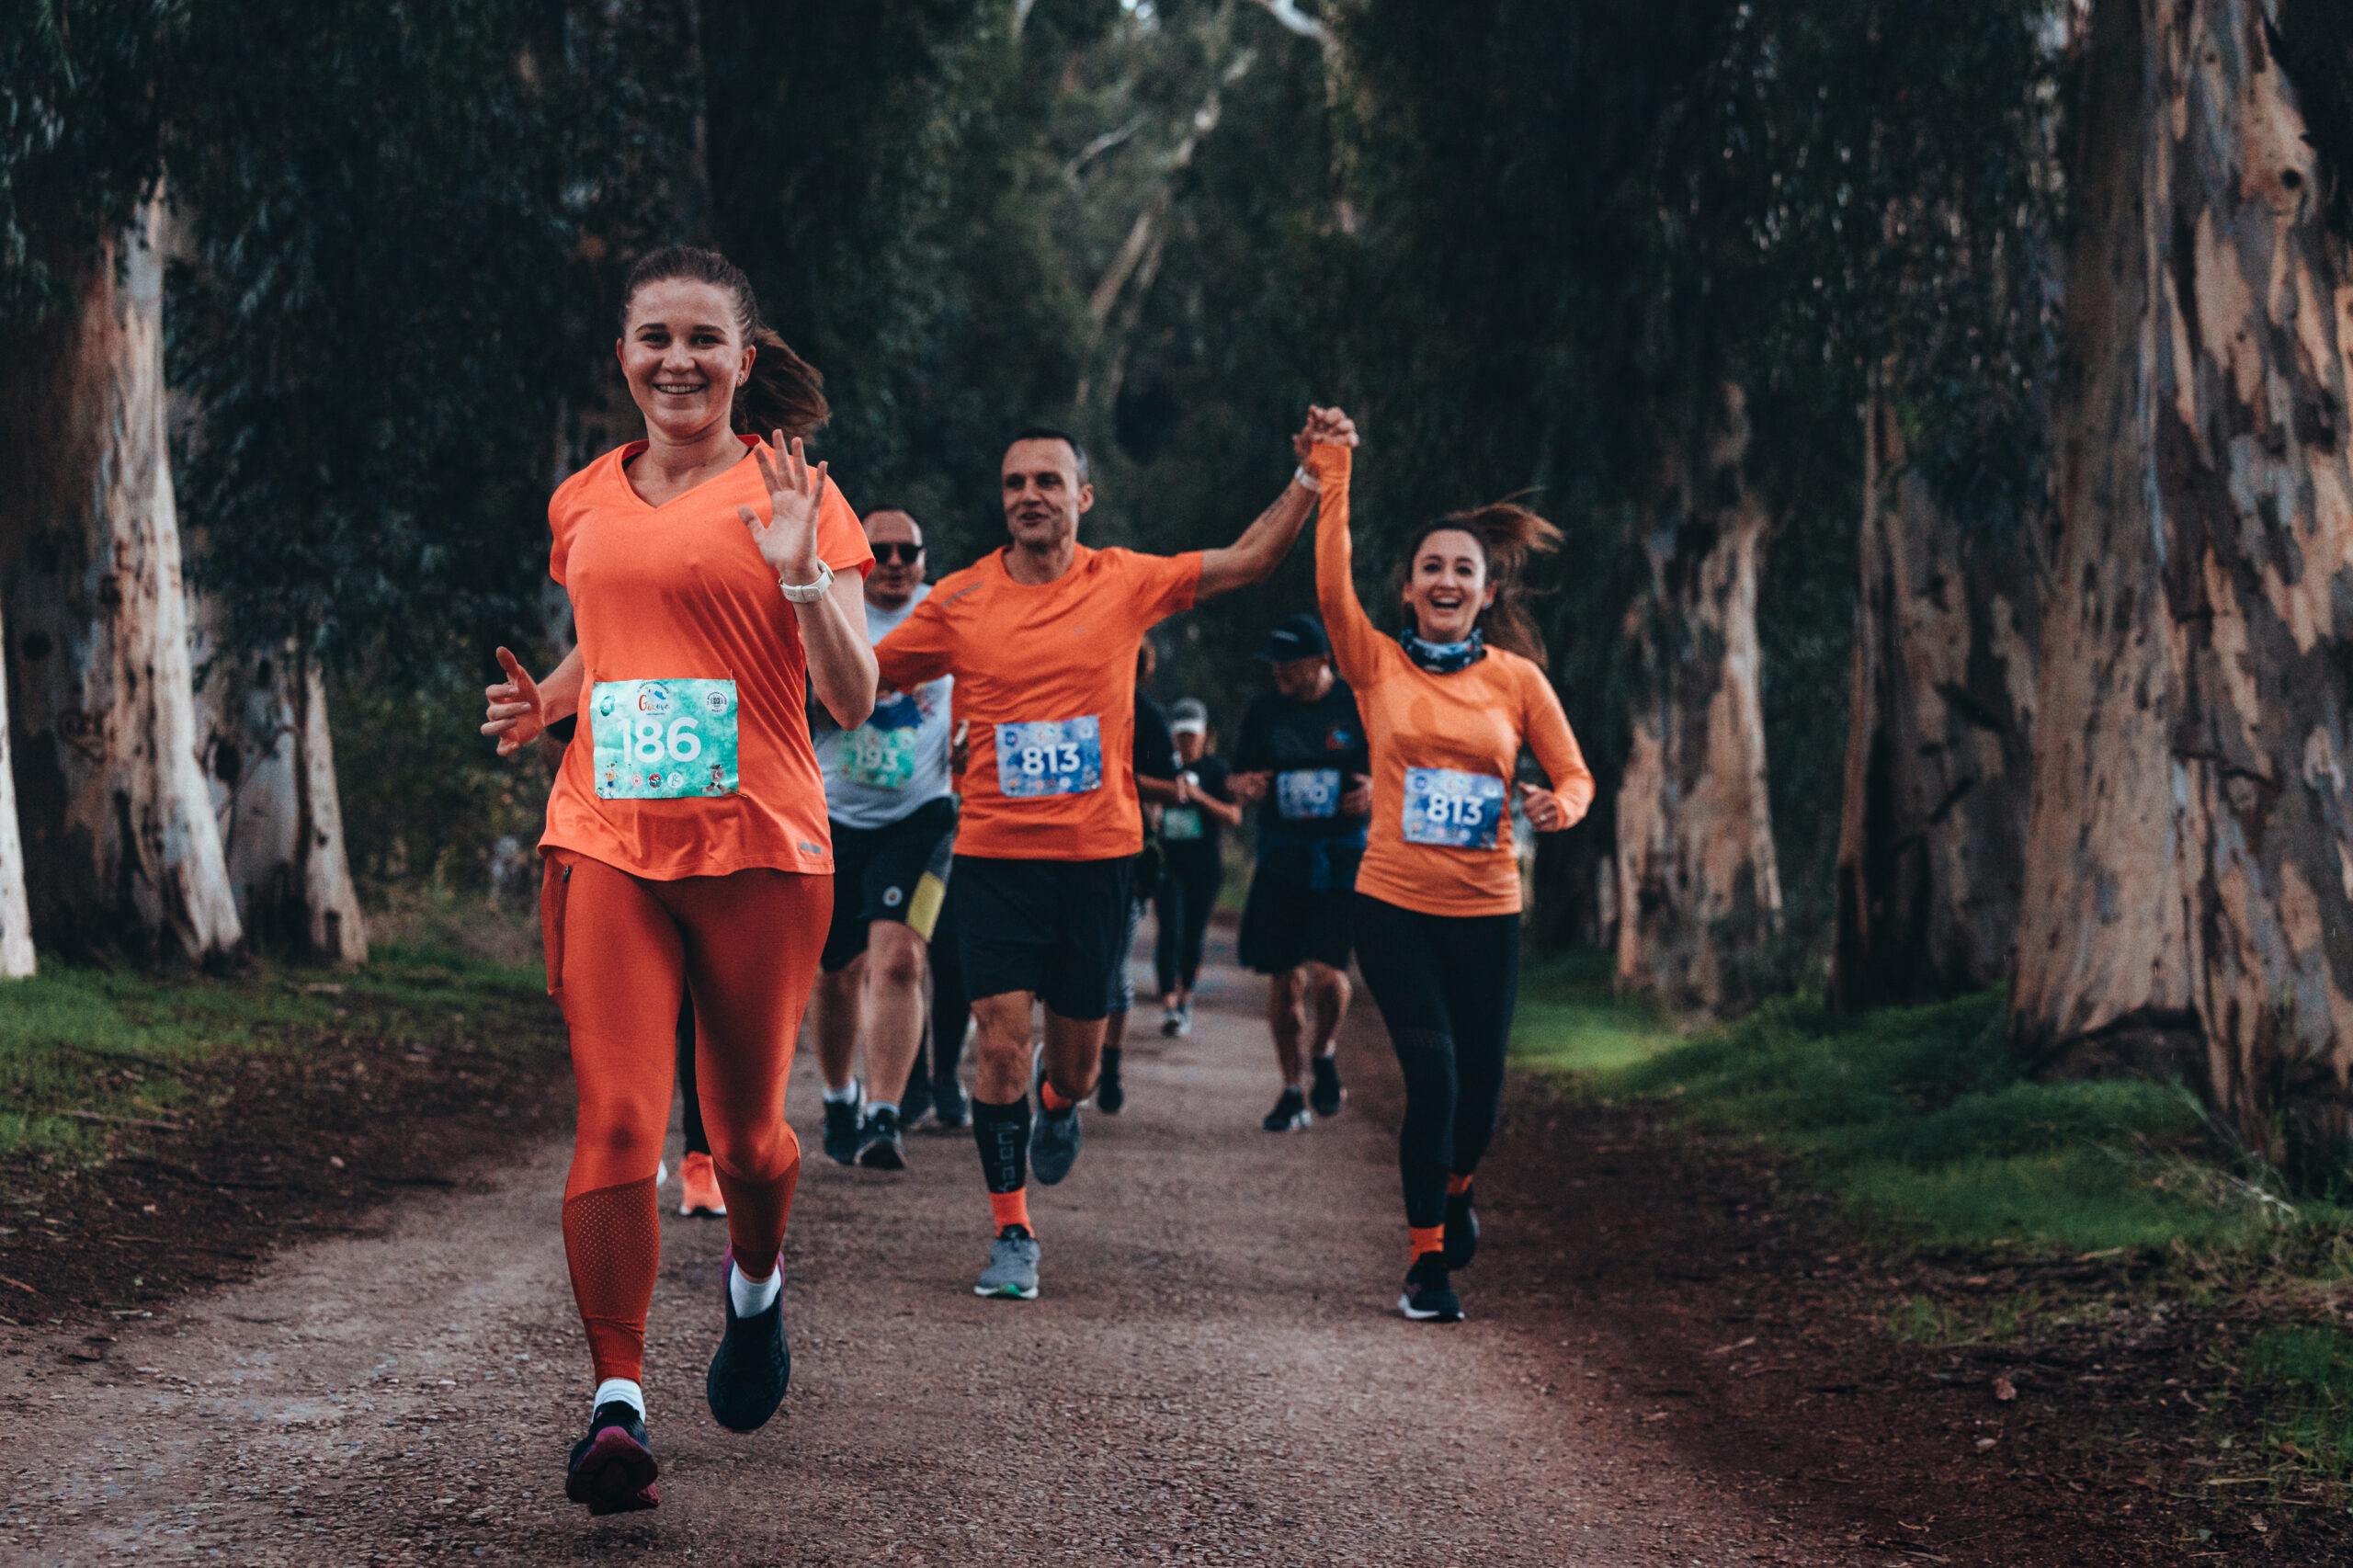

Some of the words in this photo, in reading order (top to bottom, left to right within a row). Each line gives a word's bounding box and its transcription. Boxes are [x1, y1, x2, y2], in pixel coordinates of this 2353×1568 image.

[618, 717, 701, 763] 186
[855, 743, 899, 771] 193
[1022, 743, 1080, 775] 813
[1427, 792, 1483, 825] 813
